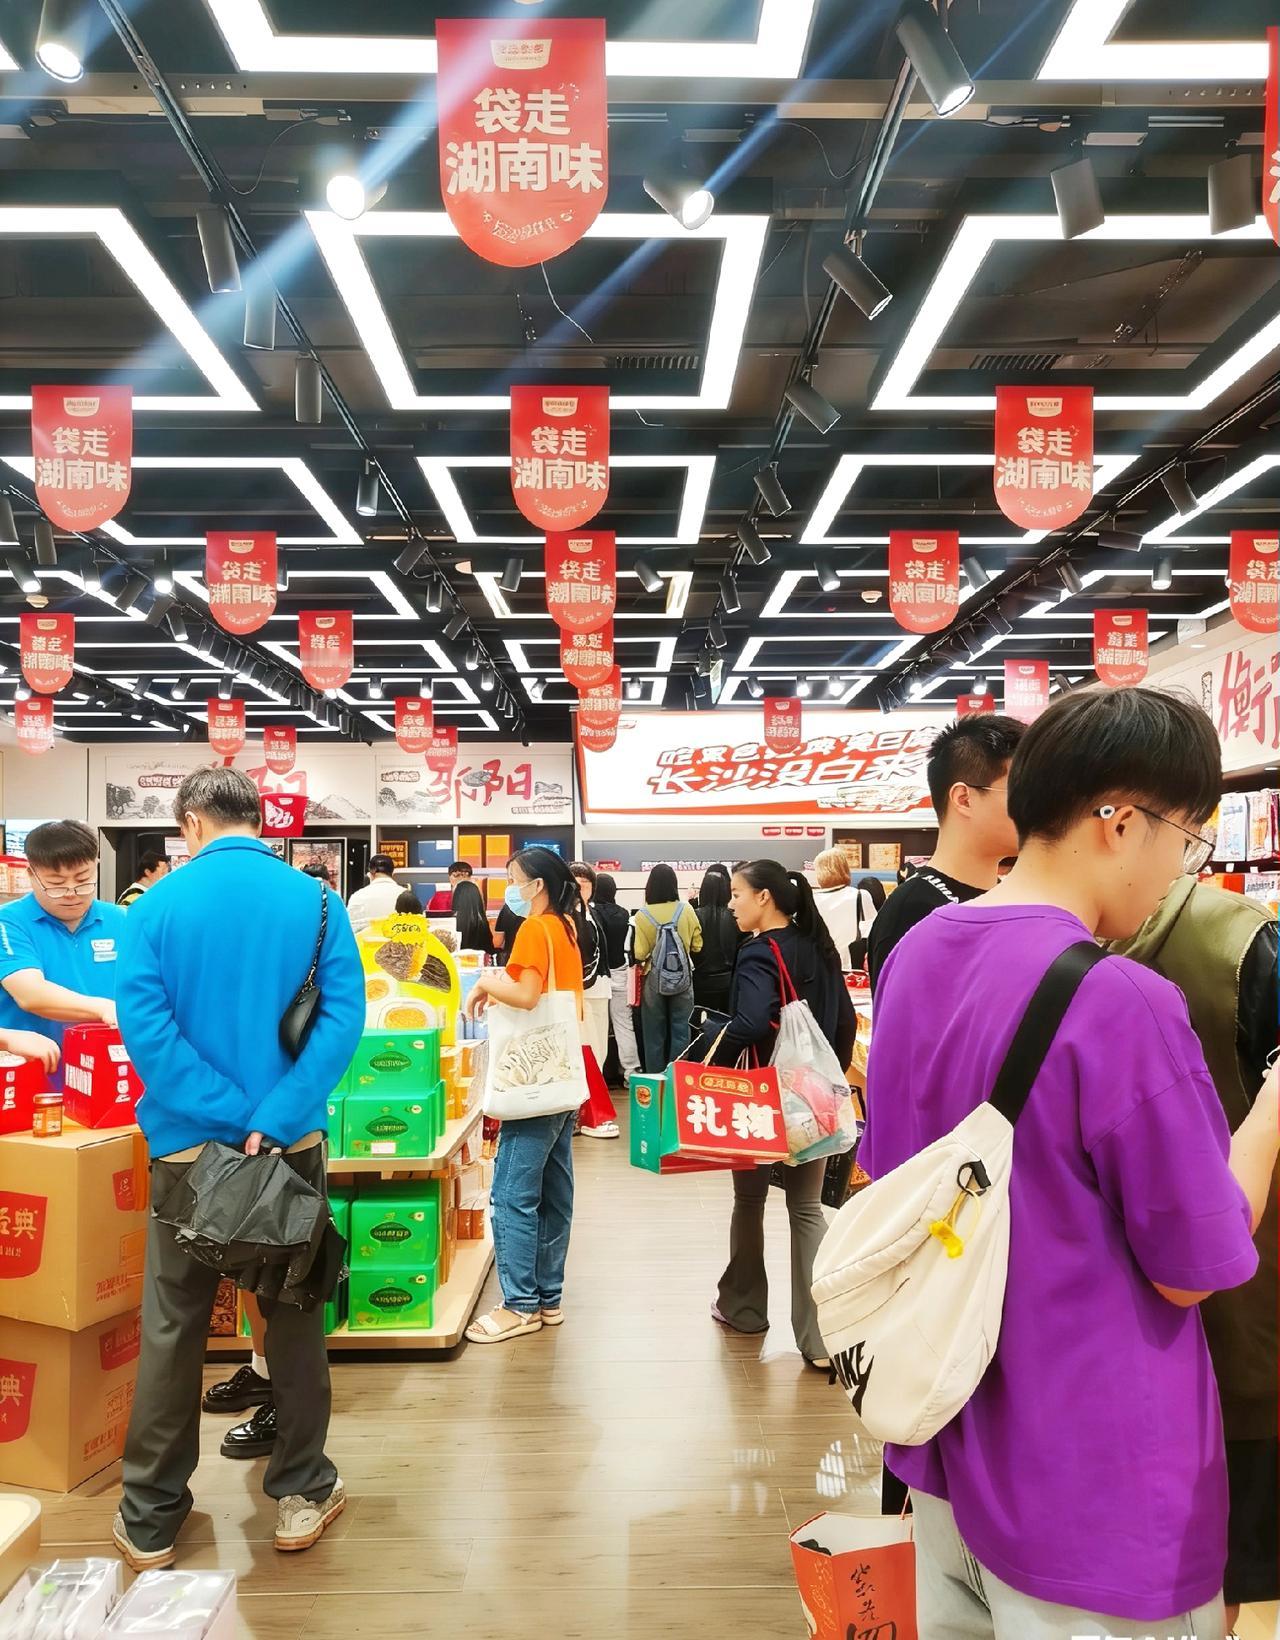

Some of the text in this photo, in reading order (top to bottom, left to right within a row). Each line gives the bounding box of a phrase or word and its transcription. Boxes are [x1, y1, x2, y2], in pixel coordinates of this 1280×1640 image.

[473, 87, 571, 135] 袋走
[445, 137, 604, 196] 湖南味
[52, 426, 110, 457] 袋走
[531, 426, 587, 457] 袋走
[1017, 426, 1073, 457] 袋走
[37, 457, 128, 492] 湖南味
[514, 457, 607, 492] 湖南味
[996, 457, 1091, 492] 湖南味
[1232, 581, 1280, 604] 湖南
[1218, 651, 1280, 753] 衡
